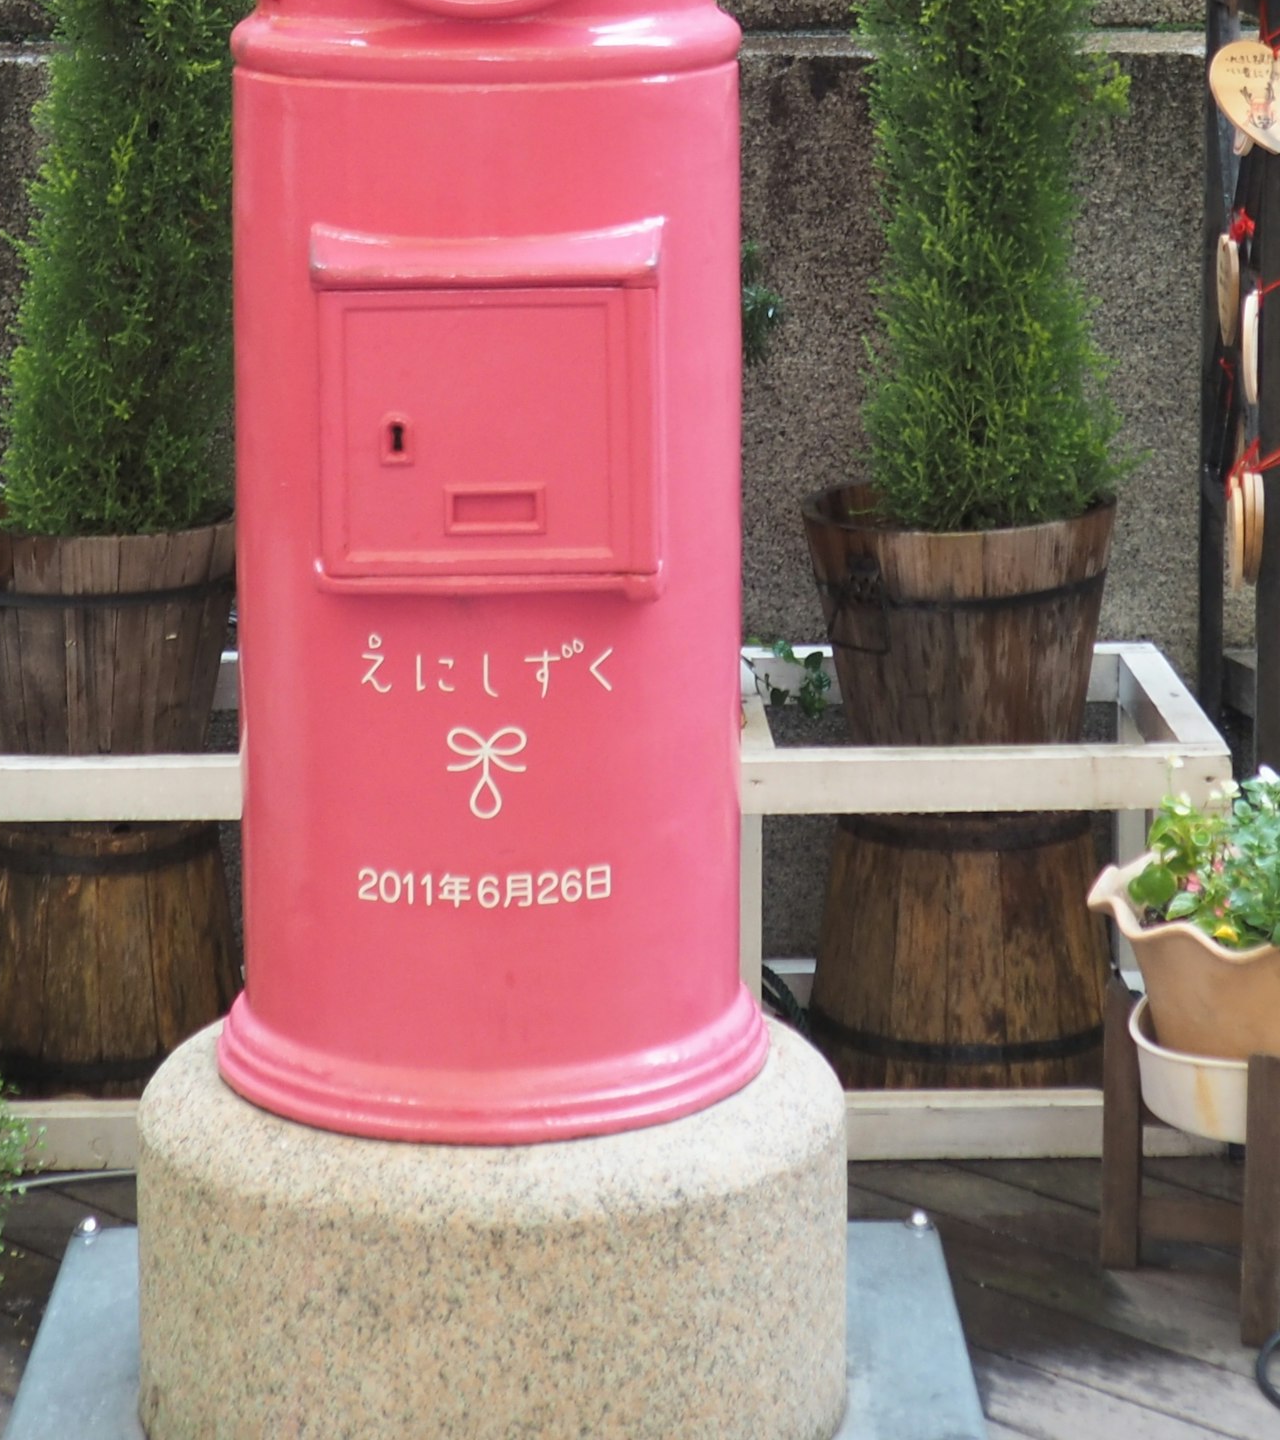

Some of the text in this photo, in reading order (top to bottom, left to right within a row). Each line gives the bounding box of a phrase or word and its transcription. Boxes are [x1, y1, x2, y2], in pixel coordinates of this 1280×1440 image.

[360, 634, 613, 699] えにしずく
[357, 863, 612, 909] 2011年6月26日
